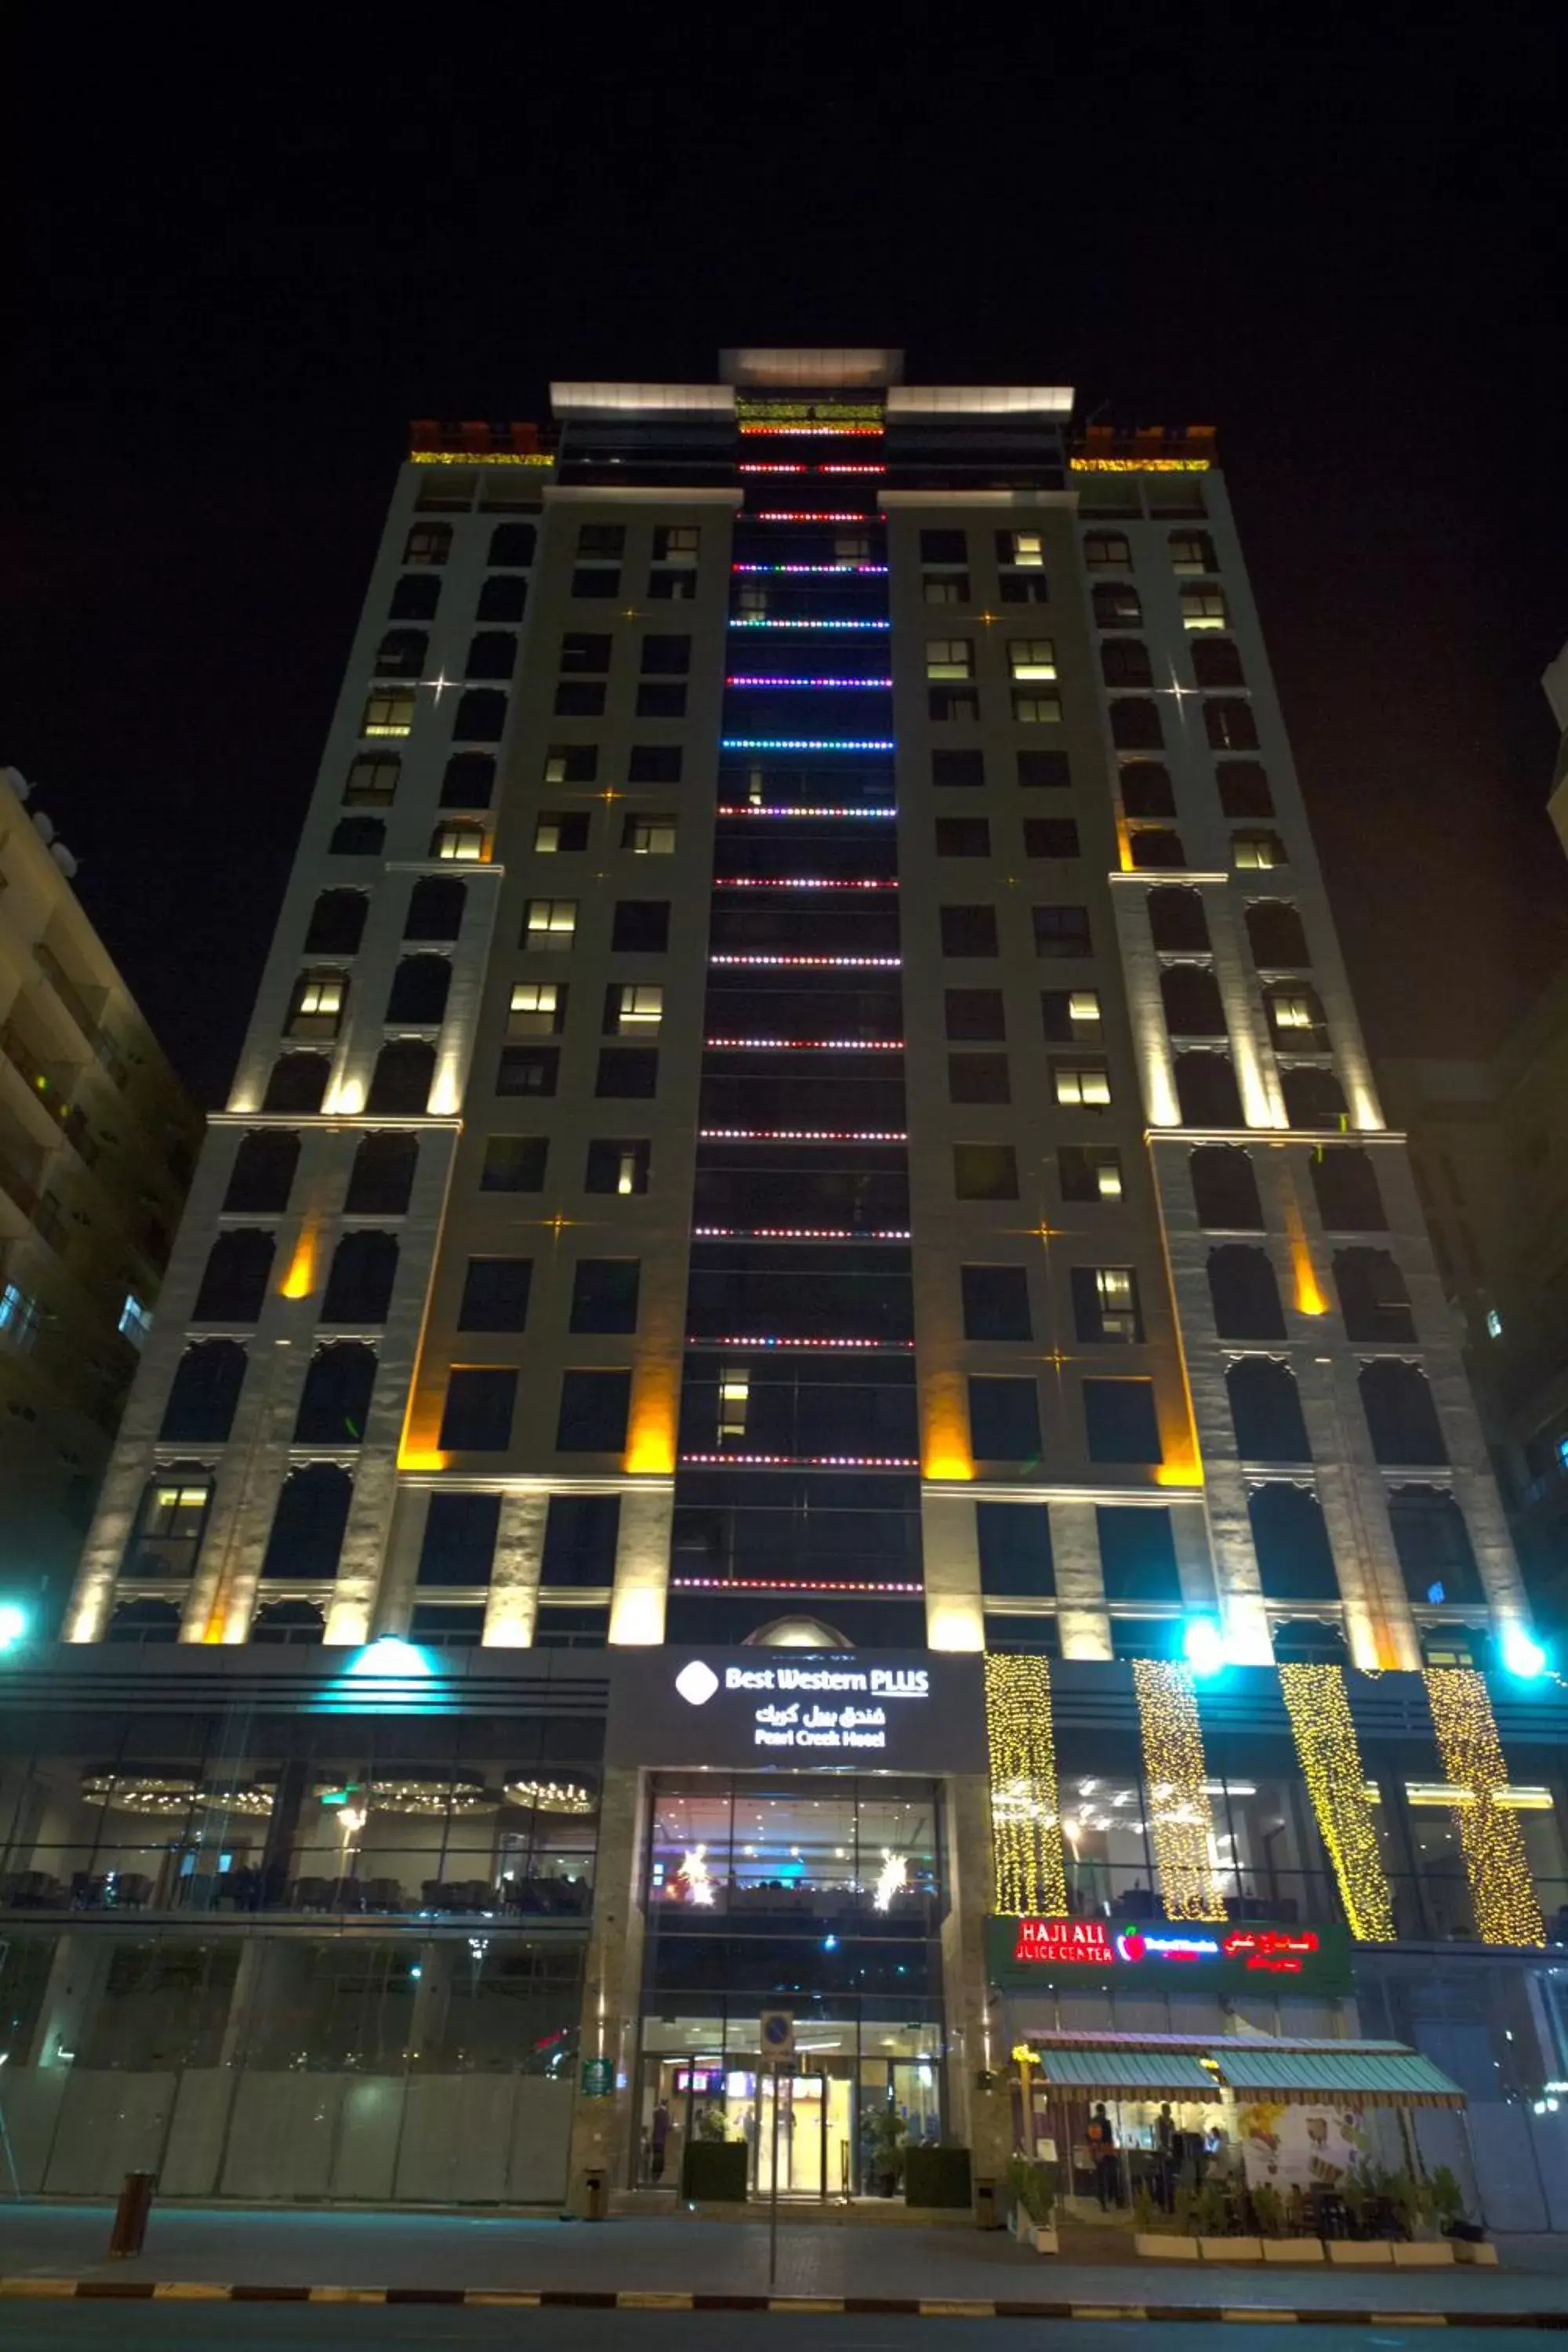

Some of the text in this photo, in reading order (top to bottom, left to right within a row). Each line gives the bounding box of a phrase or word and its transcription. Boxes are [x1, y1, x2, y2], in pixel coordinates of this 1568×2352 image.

[726, 1668, 929, 1697] Best Western PLUS
[1022, 1923, 1105, 1944] HAJI ALI
